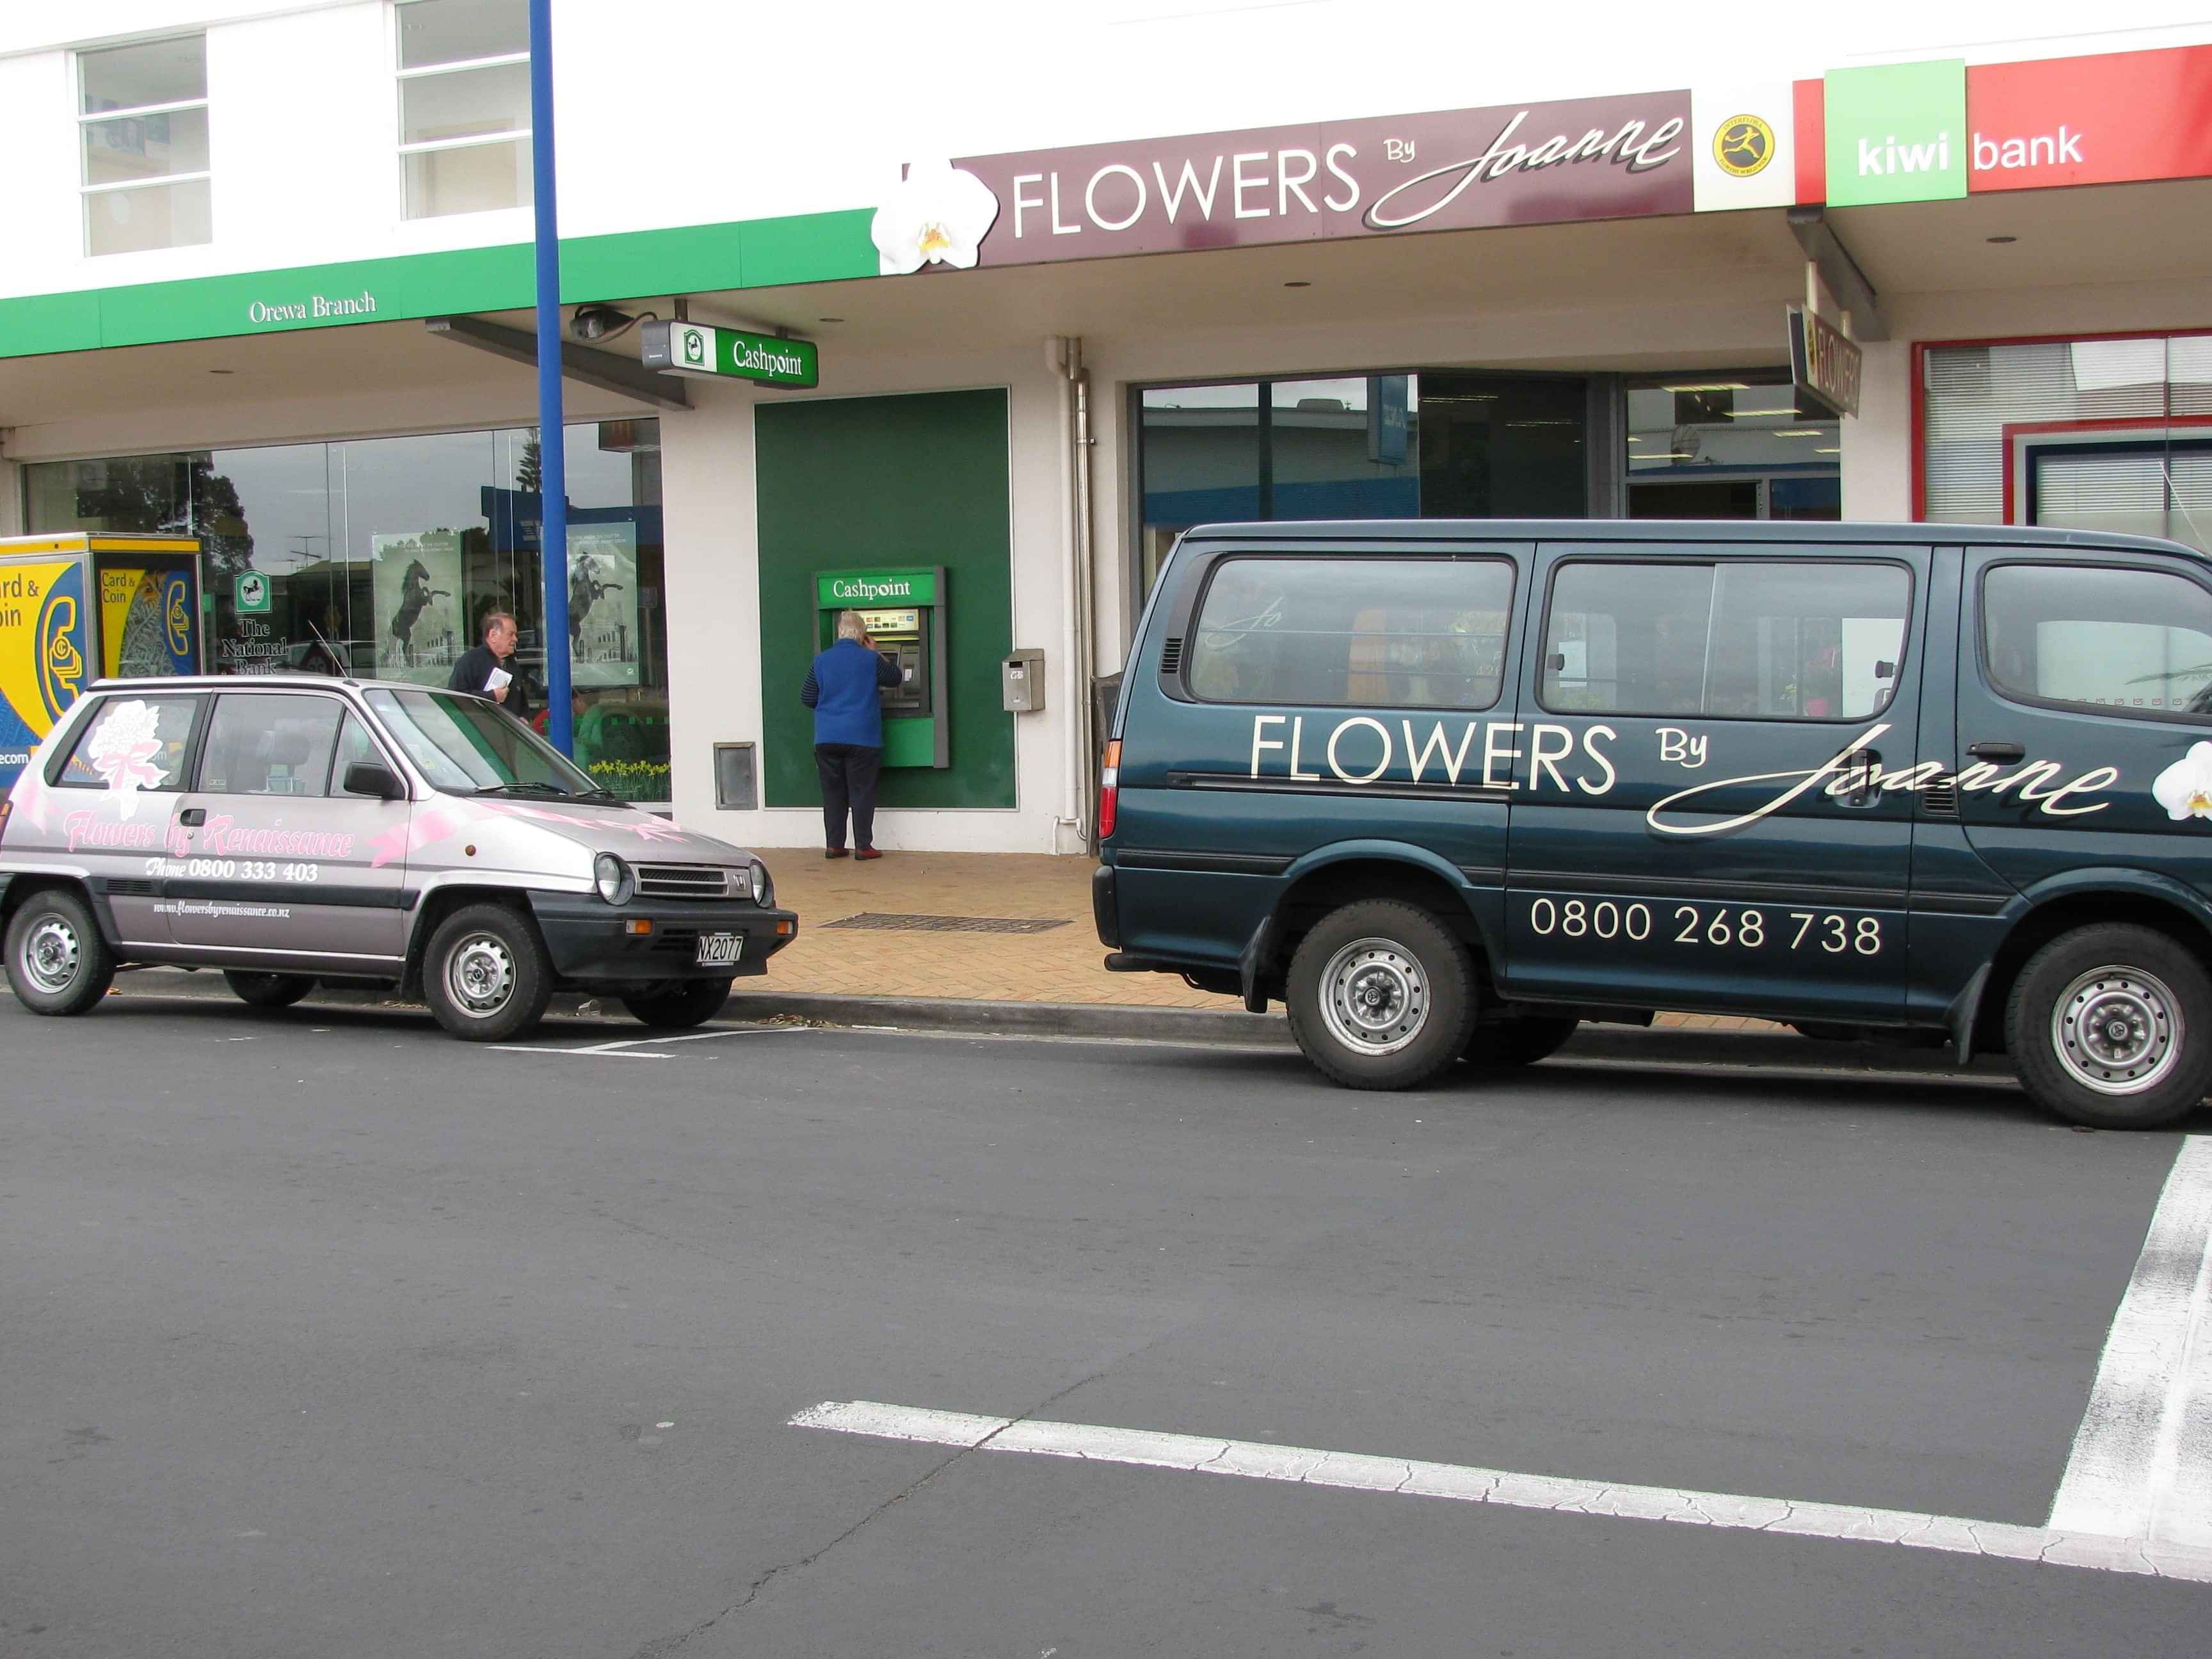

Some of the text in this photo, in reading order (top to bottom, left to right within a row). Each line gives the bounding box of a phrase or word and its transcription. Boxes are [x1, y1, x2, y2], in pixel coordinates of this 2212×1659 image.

[1858, 125, 2083, 177] kiwi bank
[1013, 110, 1684, 238] FLOWERS By Joanne
[250, 291, 376, 323] Orewa Branch
[733, 340, 803, 377] Cashpoint
[28, 580, 39, 597] &
[102, 572, 135, 587] Card &
[833, 578, 911, 600] Cashpoint
[102, 589, 126, 604] Coin
[237, 618, 271, 637] The
[221, 636, 287, 657] National
[234, 657, 277, 676] Bank
[1250, 715, 2119, 834] FLOWERS By Joanne
[63, 809, 356, 858] Flowers by Renaissance
[145, 857, 318, 882] Phone 0800 333 403
[1530, 898, 1881, 955] 0800 268 738
[697, 936, 743, 961] NX2077
